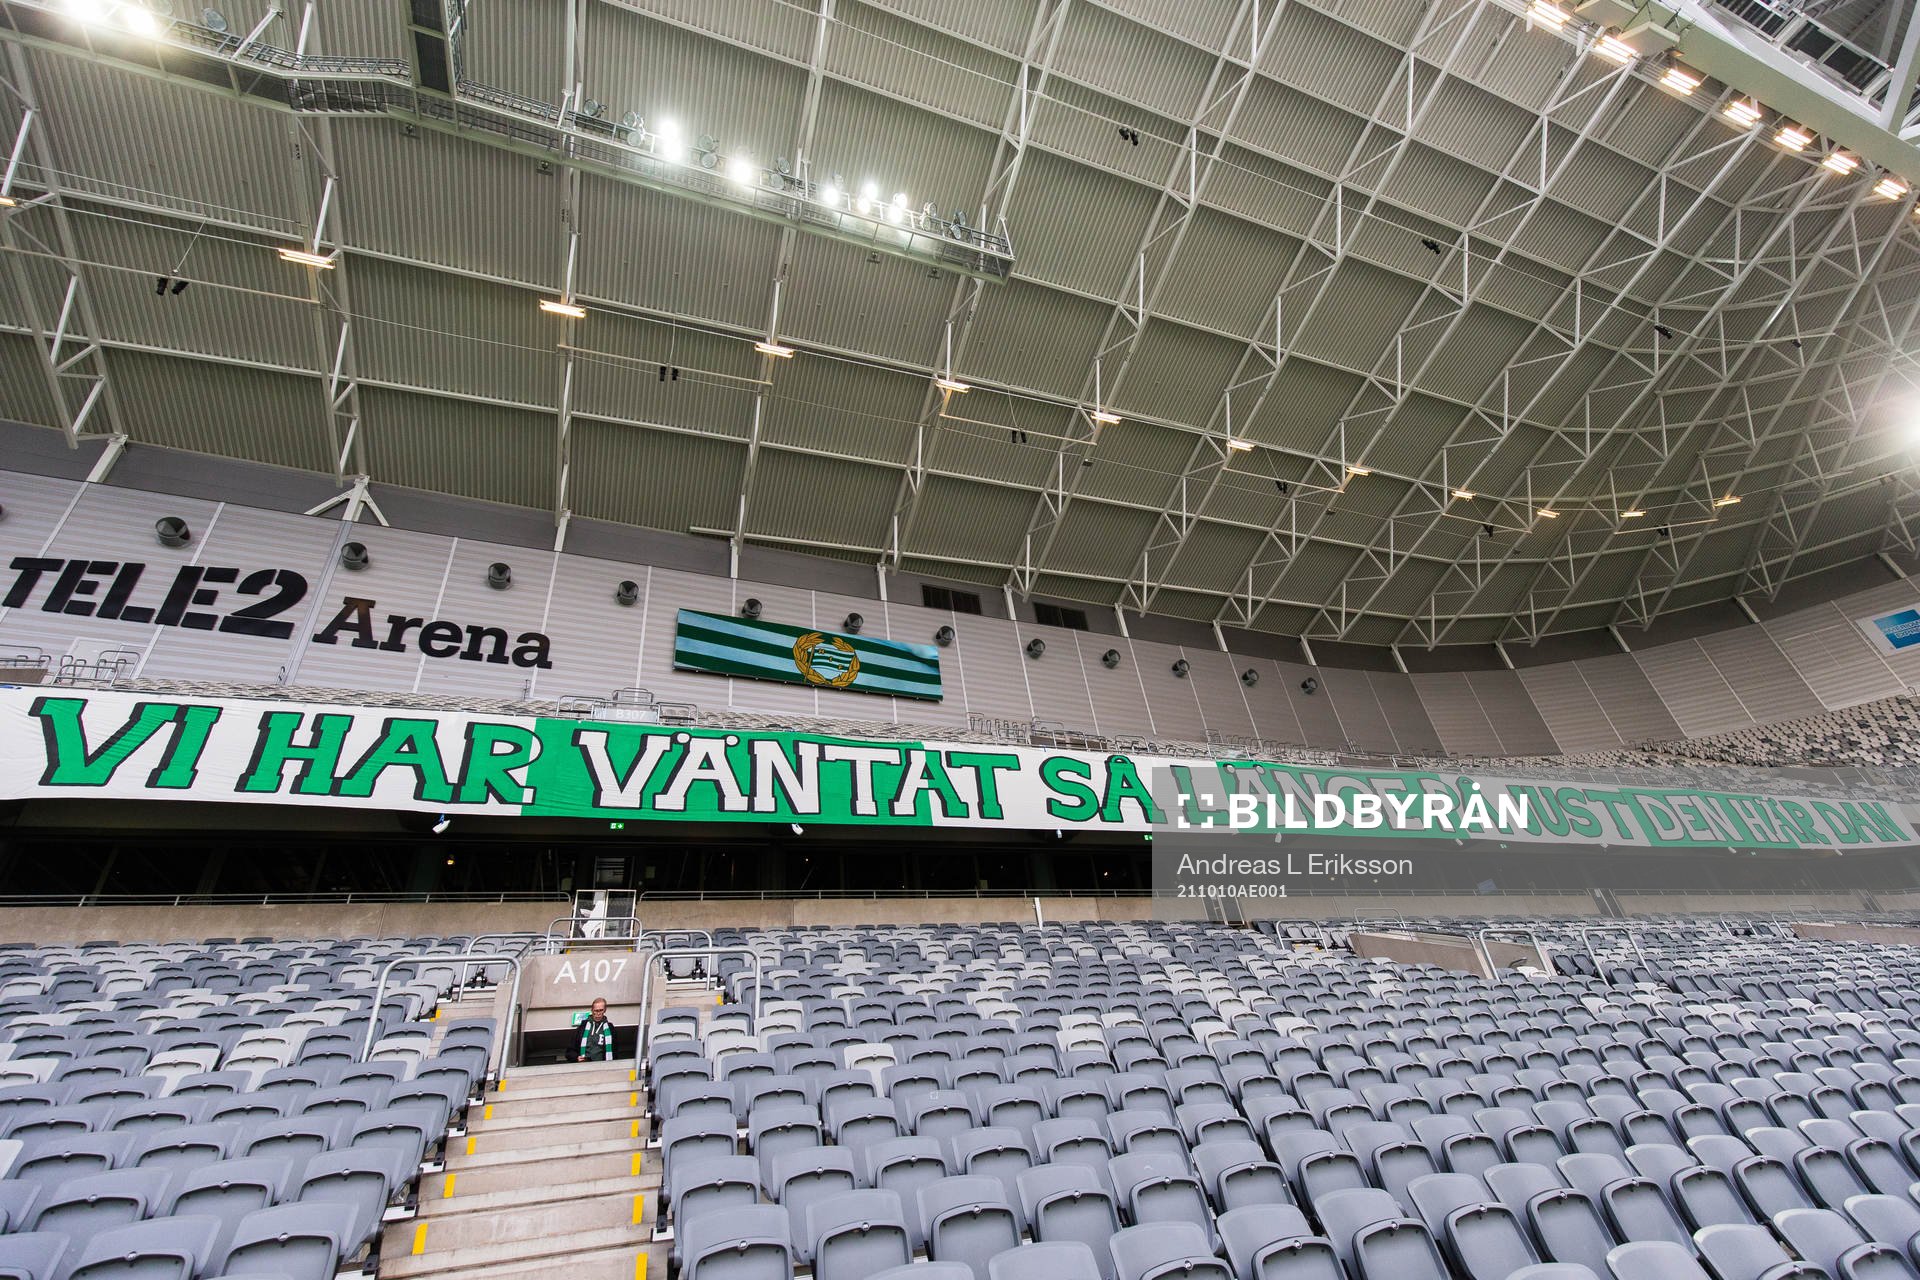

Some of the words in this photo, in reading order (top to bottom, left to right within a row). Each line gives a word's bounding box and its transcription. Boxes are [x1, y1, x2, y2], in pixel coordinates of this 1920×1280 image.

[2, 556, 308, 639] TELE2
[312, 596, 553, 670] Arena
[28, 696, 223, 790] VI
[234, 711, 544, 805] HAR
[571, 729, 1021, 821] VÄNTAT
[1040, 755, 1169, 825] SÅ
[1504, 784, 1635, 839] JUST
[1632, 793, 1746, 842] DEN
[1726, 797, 1833, 845] HÄR
[1809, 800, 1912, 844] DAN
[553, 958, 628, 985] A107
